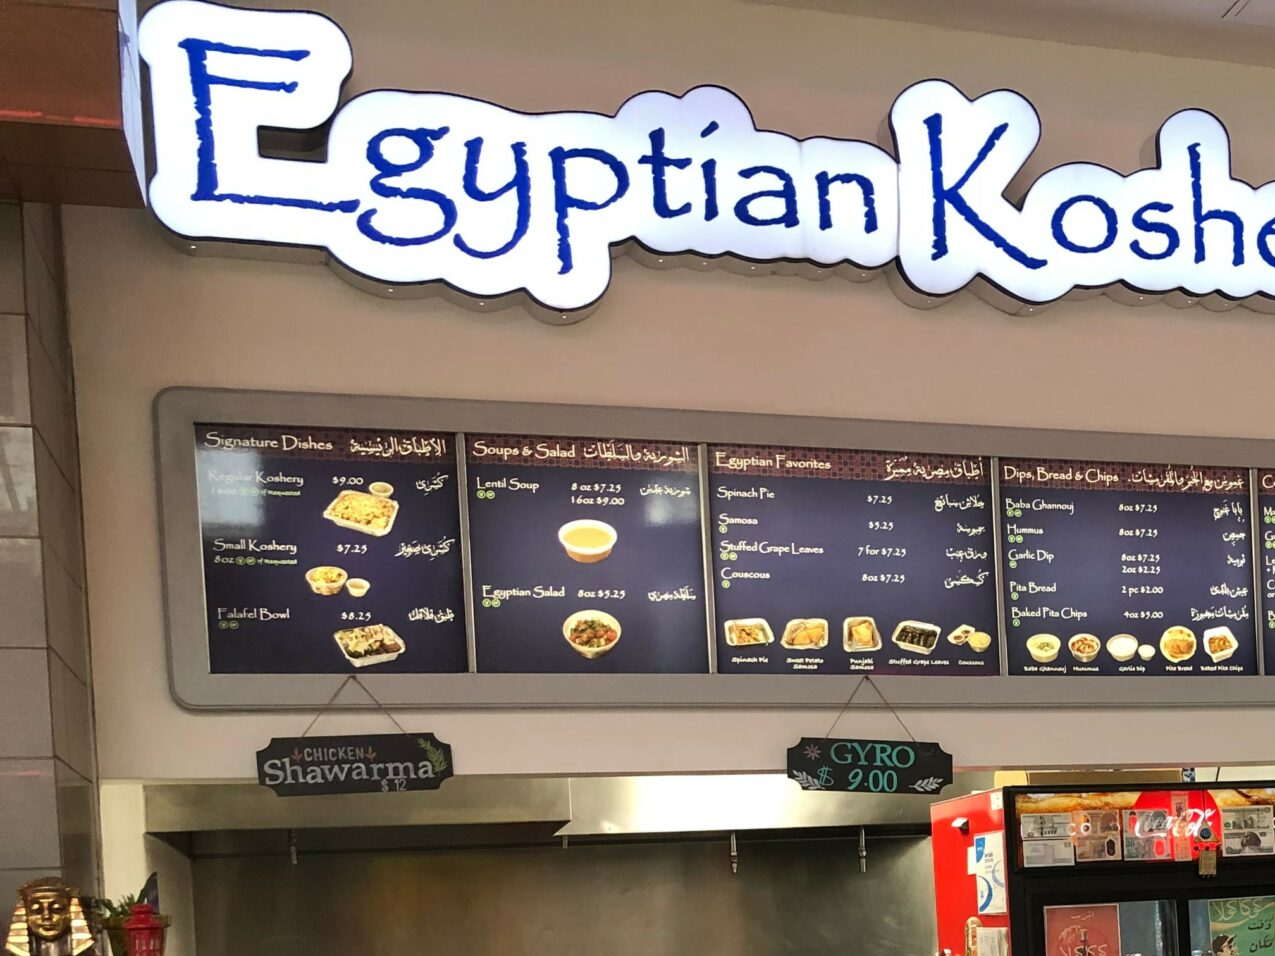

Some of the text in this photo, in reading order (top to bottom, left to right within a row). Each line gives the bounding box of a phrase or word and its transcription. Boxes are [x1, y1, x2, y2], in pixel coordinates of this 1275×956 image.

[178, 38, 878, 275] Egyptian
[204, 431, 333, 451] Signature Dishes
[472, 441, 576, 461] Soups & Salad
[715, 451, 832, 471] Egyptian Favorites
[255, 470, 304, 487] Koshery
[332, 476, 364, 486] $9.00
[1003, 465, 1119, 487] Dips, Bread & Chips
[476, 477, 540, 493] Lentil Soup
[593, 483, 622, 493] $7.25
[717, 486, 775, 500] Spinach Pie
[867, 495, 893, 504] $7.25
[595, 497, 625, 506] $9.00
[1005, 498, 1075, 515] Baba Ghannouj
[718, 513, 759, 525] Samosa
[1006, 523, 1044, 535] Hummus
[211, 539, 298, 555] Small Koshery
[337, 544, 368, 554] $7.25
[719, 540, 824, 556] Stuffed Grape Leaves
[214, 556, 235, 565] 8oz
[1008, 549, 1054, 564] Garlic Dip
[720, 567, 771, 579] Couscous
[481, 585, 566, 600] Egyptian Salad
[597, 589, 626, 599] $5.25
[1009, 581, 1057, 594] Pita Bread
[217, 607, 290, 621] Falafel Bowl
[341, 611, 372, 621] $8.25
[1011, 606, 1088, 621] Baked Pita Chips
[303, 747, 365, 762] CHICKEN
[830, 742, 916, 769] GYRO
[263, 757, 436, 786] Shawarma
[817, 765, 898, 792] $ 9.00
[381, 778, 407, 793] $ 12
